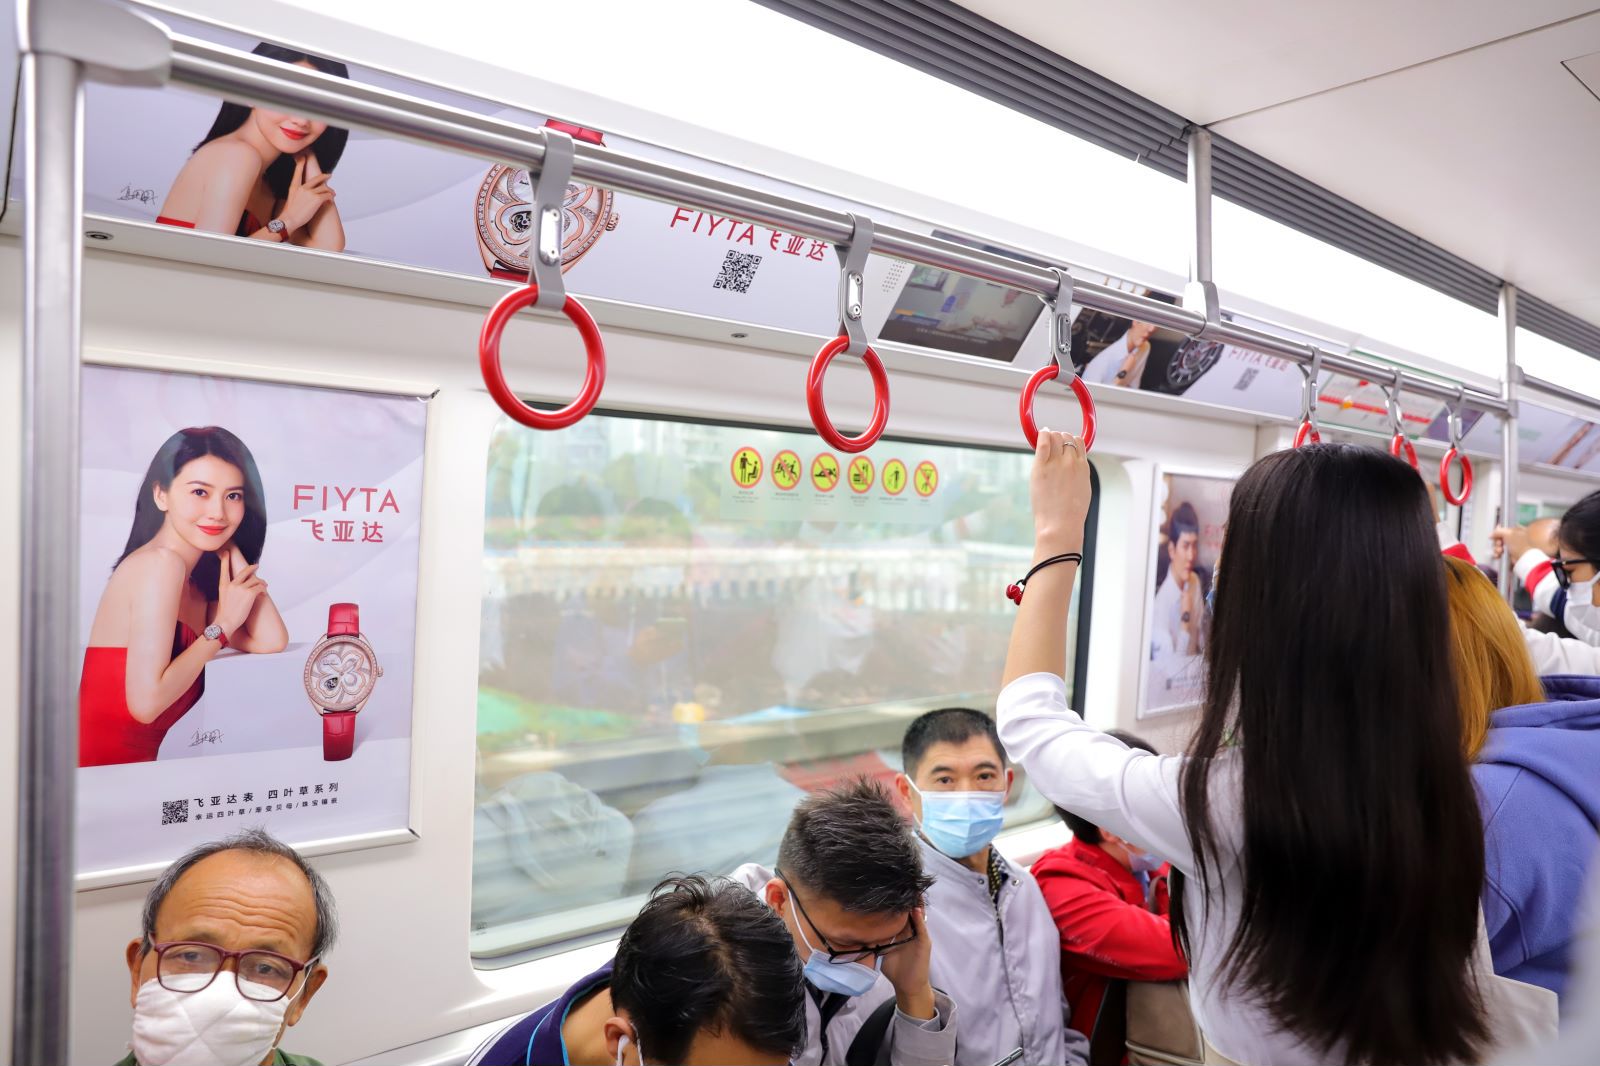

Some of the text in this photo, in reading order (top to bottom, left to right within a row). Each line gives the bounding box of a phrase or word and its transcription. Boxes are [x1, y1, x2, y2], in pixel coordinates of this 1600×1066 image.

[670, 207, 754, 246] FIYTA
[293, 484, 400, 513] FIYTA
[300, 519, 383, 543] 飞亚达
[194, 782, 339, 808] 飞亚达表 四叶草系列
